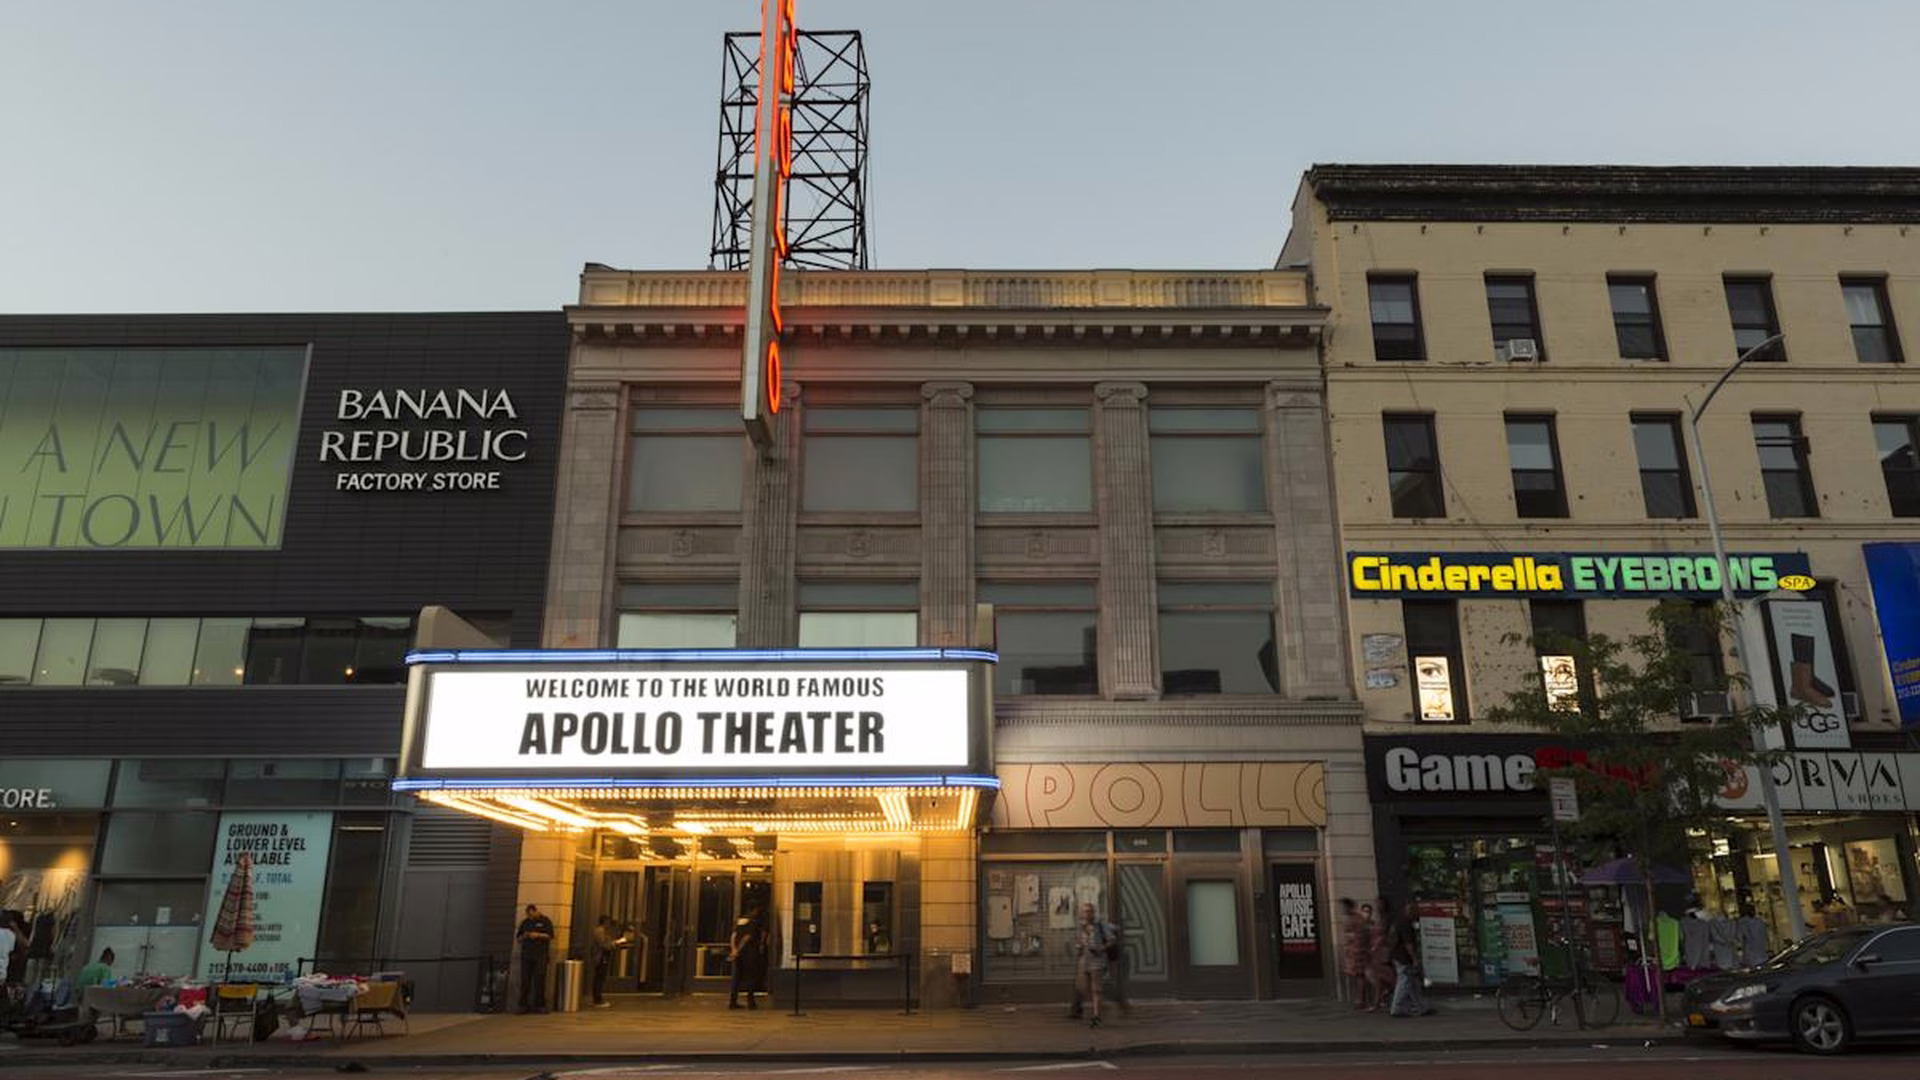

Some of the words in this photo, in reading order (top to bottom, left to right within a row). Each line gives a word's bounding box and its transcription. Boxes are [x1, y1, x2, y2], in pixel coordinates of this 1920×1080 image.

[337, 388, 518, 420] BANANA
[20, 421, 68, 473] A
[97, 421, 281, 473] NEW
[319, 430, 528, 462] REPUBLIC
[336, 472, 428, 490] FACTORY
[432, 472, 500, 489] STORE
[40, 494, 276, 547] TOWN
[1352, 556, 1564, 592] Cinderella
[1571, 556, 1778, 591] EYEBROWS
[1782, 577, 1812, 588] SPA
[526, 678, 630, 698] WELCOME
[638, 678, 663, 698] TO
[670, 678, 708, 697] THE
[715, 677, 790, 697] WORLD
[797, 677, 884, 697] FAMOUS
[518, 711, 683, 755] APOLLO
[697, 711, 884, 754] THEATER
[1769, 758, 1897, 788] ORVA
[228, 823, 278, 837] GROUND
[280, 823, 289, 836] &
[226, 838, 269, 851] LOWER
[271, 838, 306, 851] LEVEL
[1279, 884, 1313, 898] APOLLO
[1279, 899, 1314, 915] MUSIC
[1281, 915, 1315, 938] CAFE
